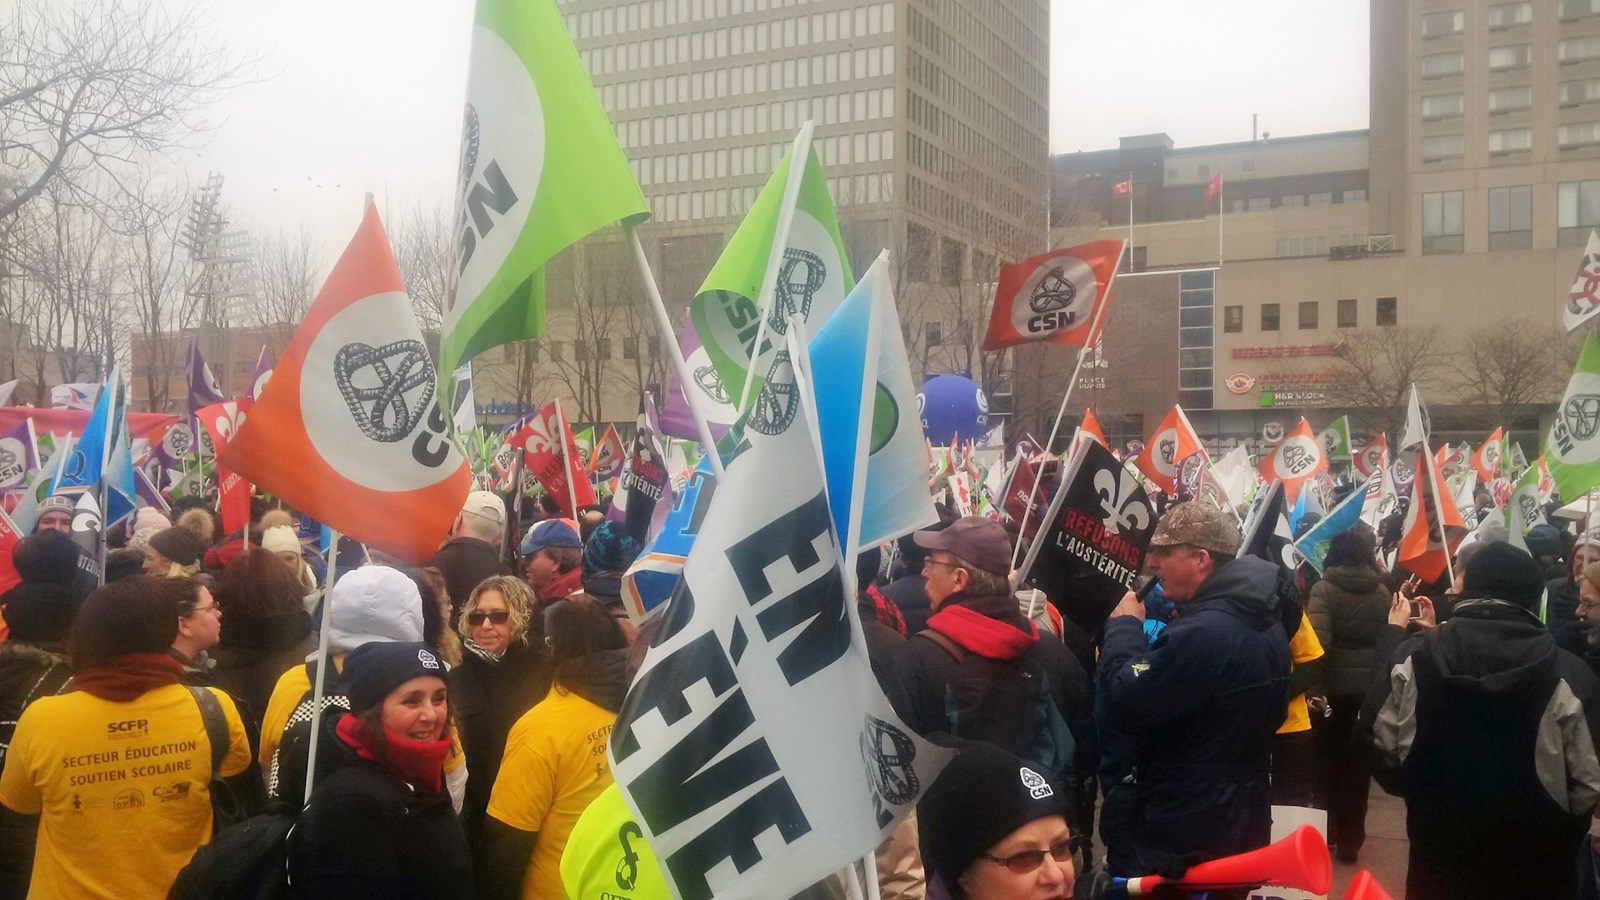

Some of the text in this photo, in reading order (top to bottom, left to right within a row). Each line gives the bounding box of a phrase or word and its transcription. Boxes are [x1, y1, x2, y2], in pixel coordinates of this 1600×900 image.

[713, 289, 773, 358] SN
[1027, 311, 1077, 334] CSN
[411, 392, 452, 469] CS
[1290, 454, 1317, 476] CSN
[628, 471, 663, 502] STÉRITÉ
[1016, 489, 1039, 511] nos
[1063, 506, 1142, 566] REFUSONS
[1055, 529, 1138, 591] L'AUSTÉRITÉ
[723, 489, 853, 689] EN
[423, 661, 438, 669] CSN
[107, 718, 149, 735] SCFP
[587, 723, 615, 744] SECTE
[62, 740, 196, 769] SECTEUR ÉDUCATION
[70, 759, 192, 787] SOUTIEN SCOLAIRE
[1032, 786, 1051, 798] CSN
